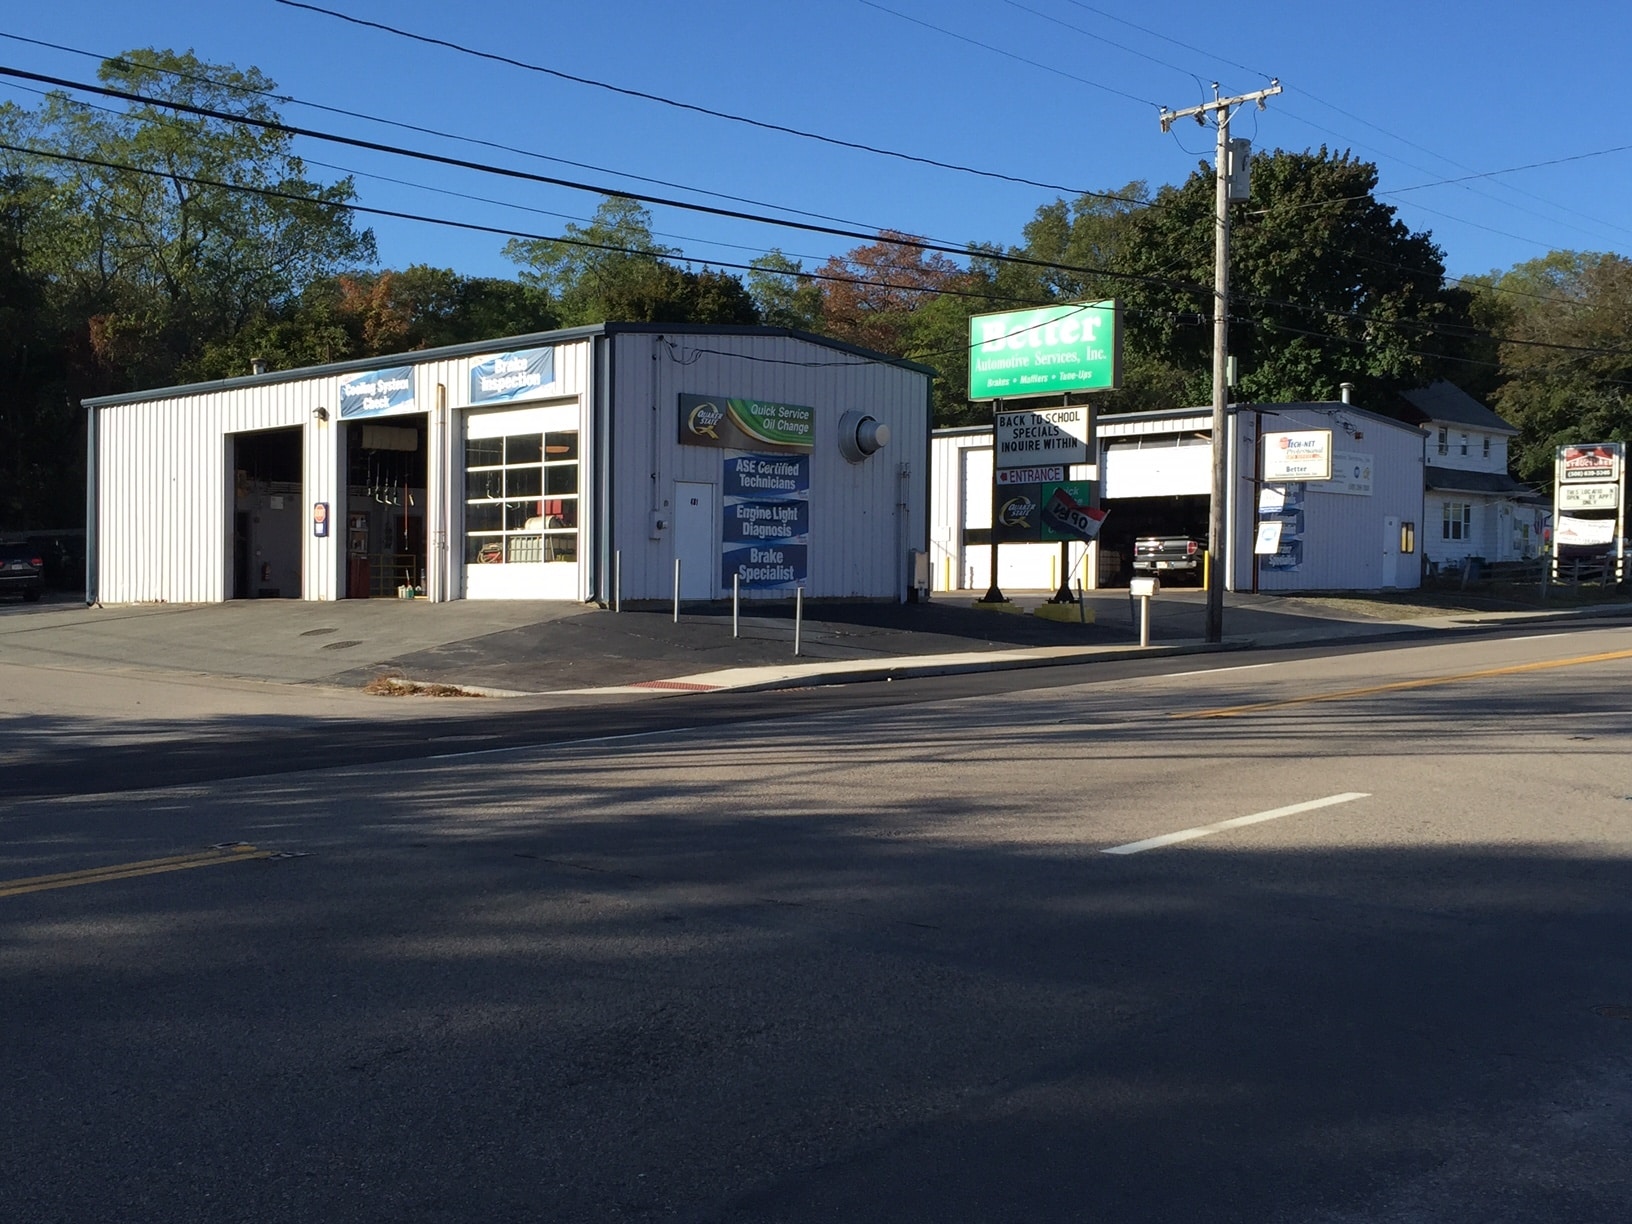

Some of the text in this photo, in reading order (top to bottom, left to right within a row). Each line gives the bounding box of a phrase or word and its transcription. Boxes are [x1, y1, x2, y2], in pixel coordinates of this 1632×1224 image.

[981, 315, 1103, 352] Better
[494, 357, 528, 374] Brake
[975, 345, 1107, 372] Automotive Services, Inc.
[480, 373, 541, 393] Inspection
[987, 370, 1092, 388] Brakes Mufflers Tune-Ups
[344, 378, 409, 397] Cooling System
[363, 397, 390, 410] Check
[697, 410, 723, 420] QUAKER
[751, 404, 809, 420] Quick Service
[1000, 411, 1080, 427] BACK TO SCHOOL
[700, 418, 718, 426] STATE
[763, 419, 809, 434] Oil Change
[1013, 426, 1059, 439] SPECIALS
[1001, 438, 1078, 452] INQUIRE WITHIN
[736, 459, 799, 476] ASE Certified
[1009, 468, 1060, 482] ENTRANCE
[1286, 465, 1307, 473] Better
[739, 474, 796, 490] Technicians
[736, 505, 799, 523] Engine Light
[742, 522, 792, 539] Diagnosis
[750, 548, 784, 564] Brake
[738, 564, 795, 583] Specialist
